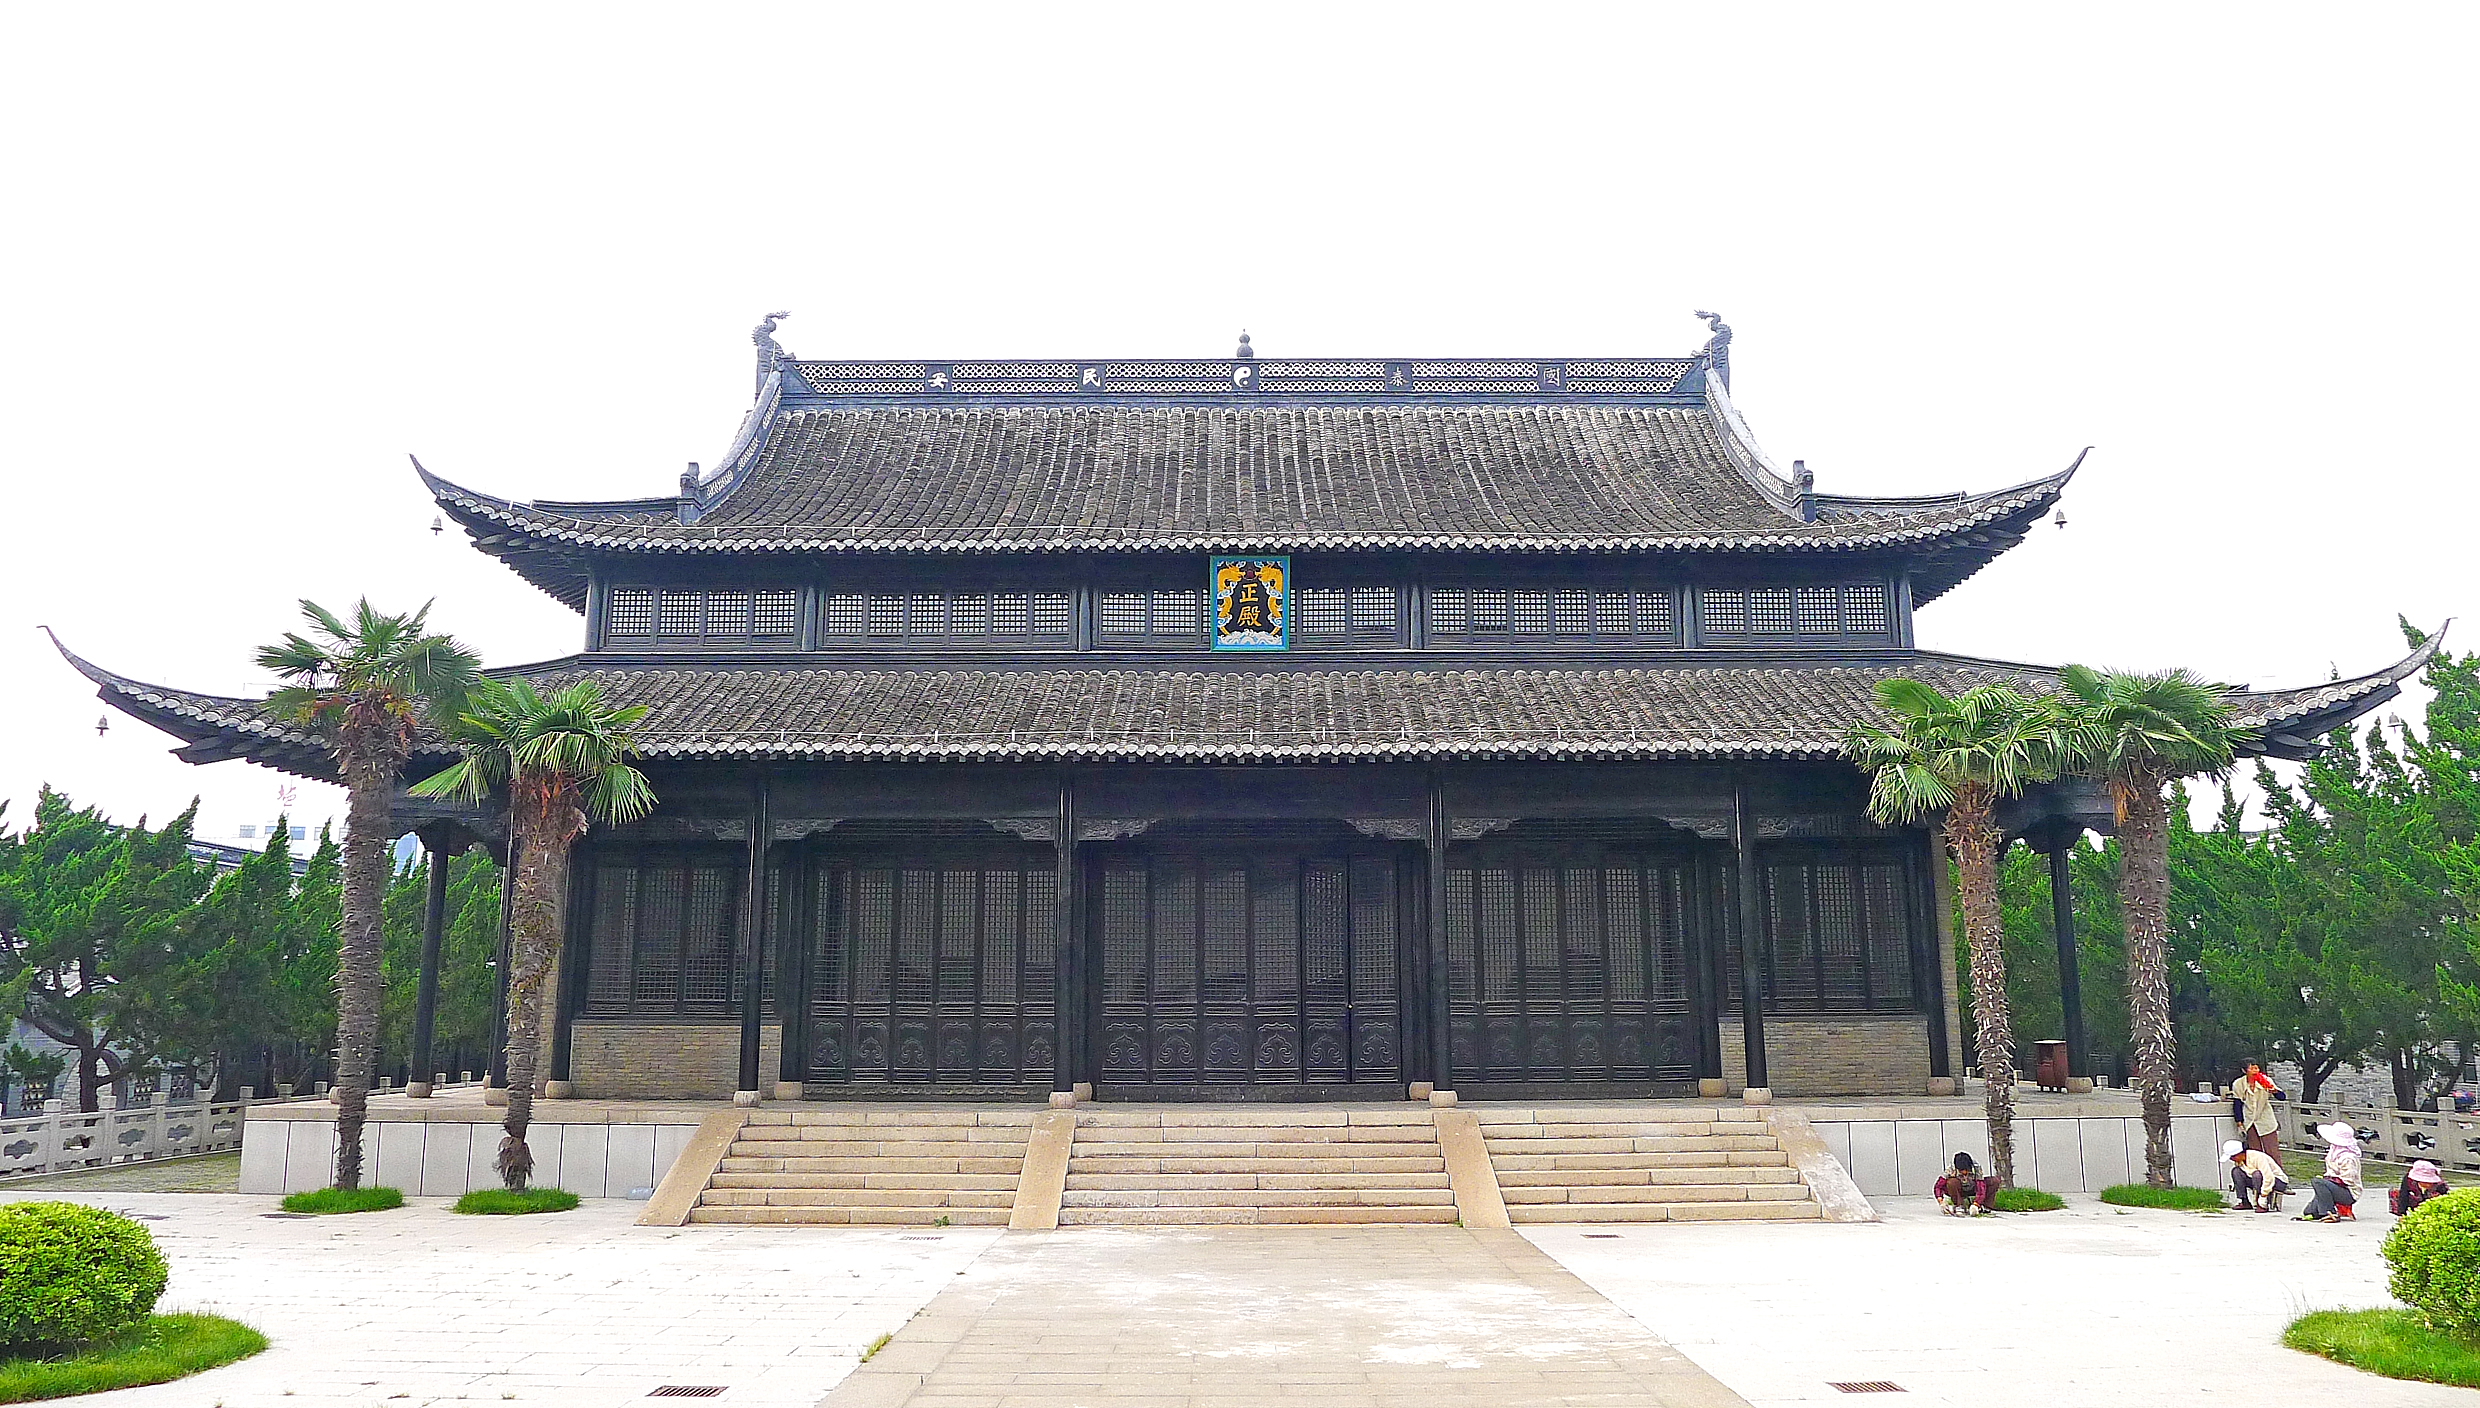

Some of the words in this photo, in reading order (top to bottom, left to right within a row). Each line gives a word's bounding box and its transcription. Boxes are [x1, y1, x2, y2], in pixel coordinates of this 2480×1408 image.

[927, 371, 949, 390] 安
[1082, 367, 1101, 388] 民
[1237, 582, 1263, 628] 正殿
